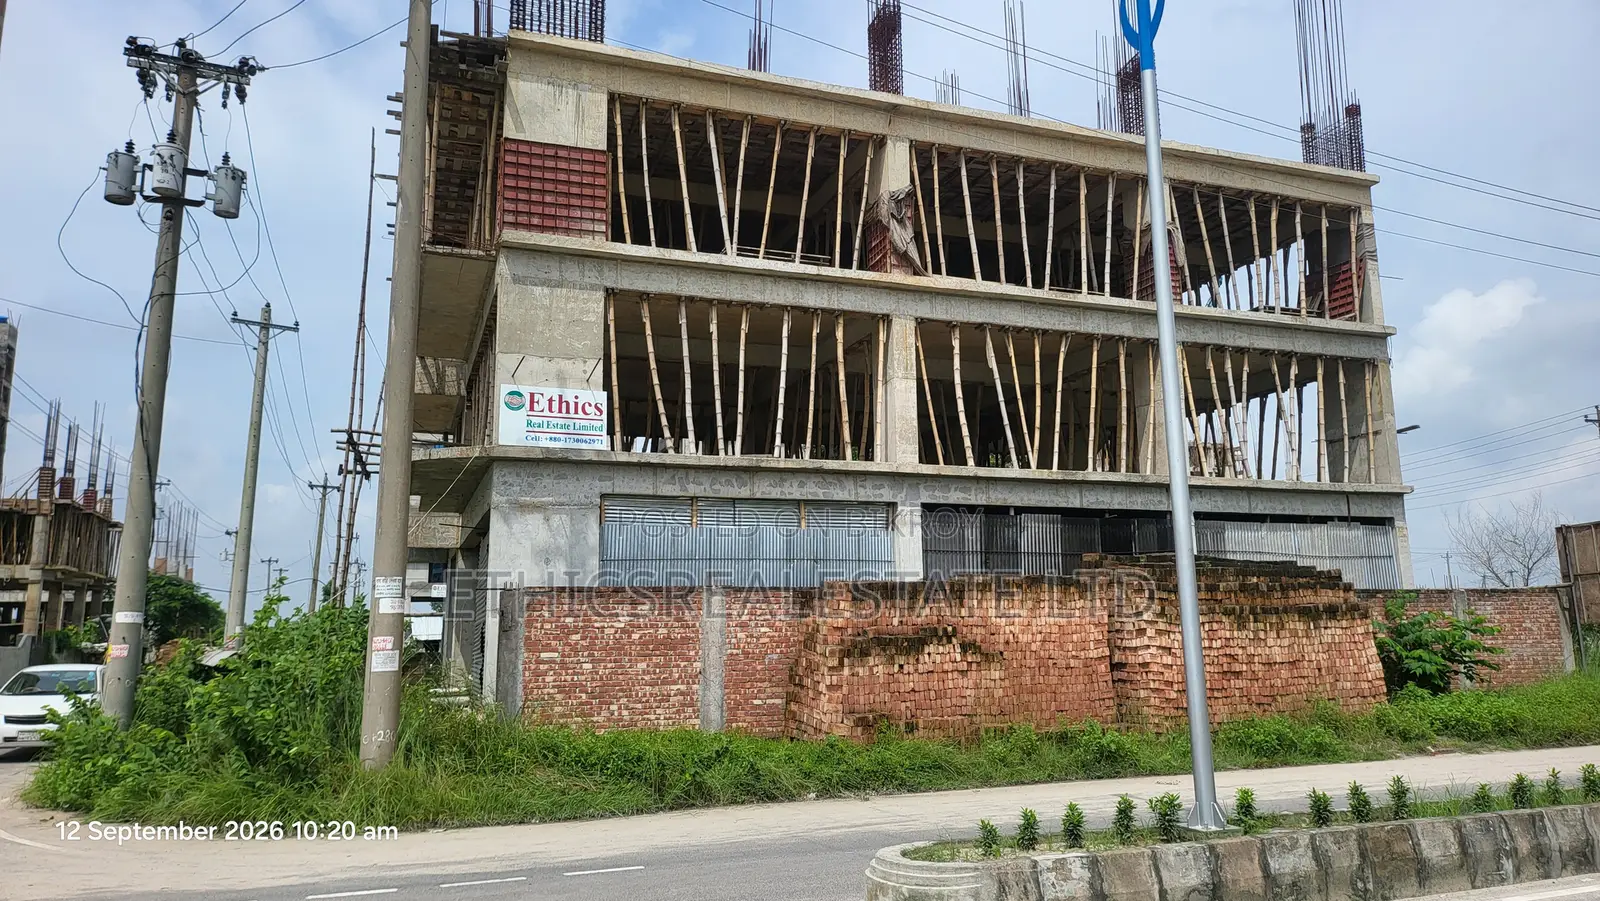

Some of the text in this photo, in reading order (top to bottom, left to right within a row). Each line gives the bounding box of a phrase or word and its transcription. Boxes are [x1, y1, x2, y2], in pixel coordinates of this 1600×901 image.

[528, 392, 604, 417] Ethics
[526, 419, 604, 432] Real Estate Limited
